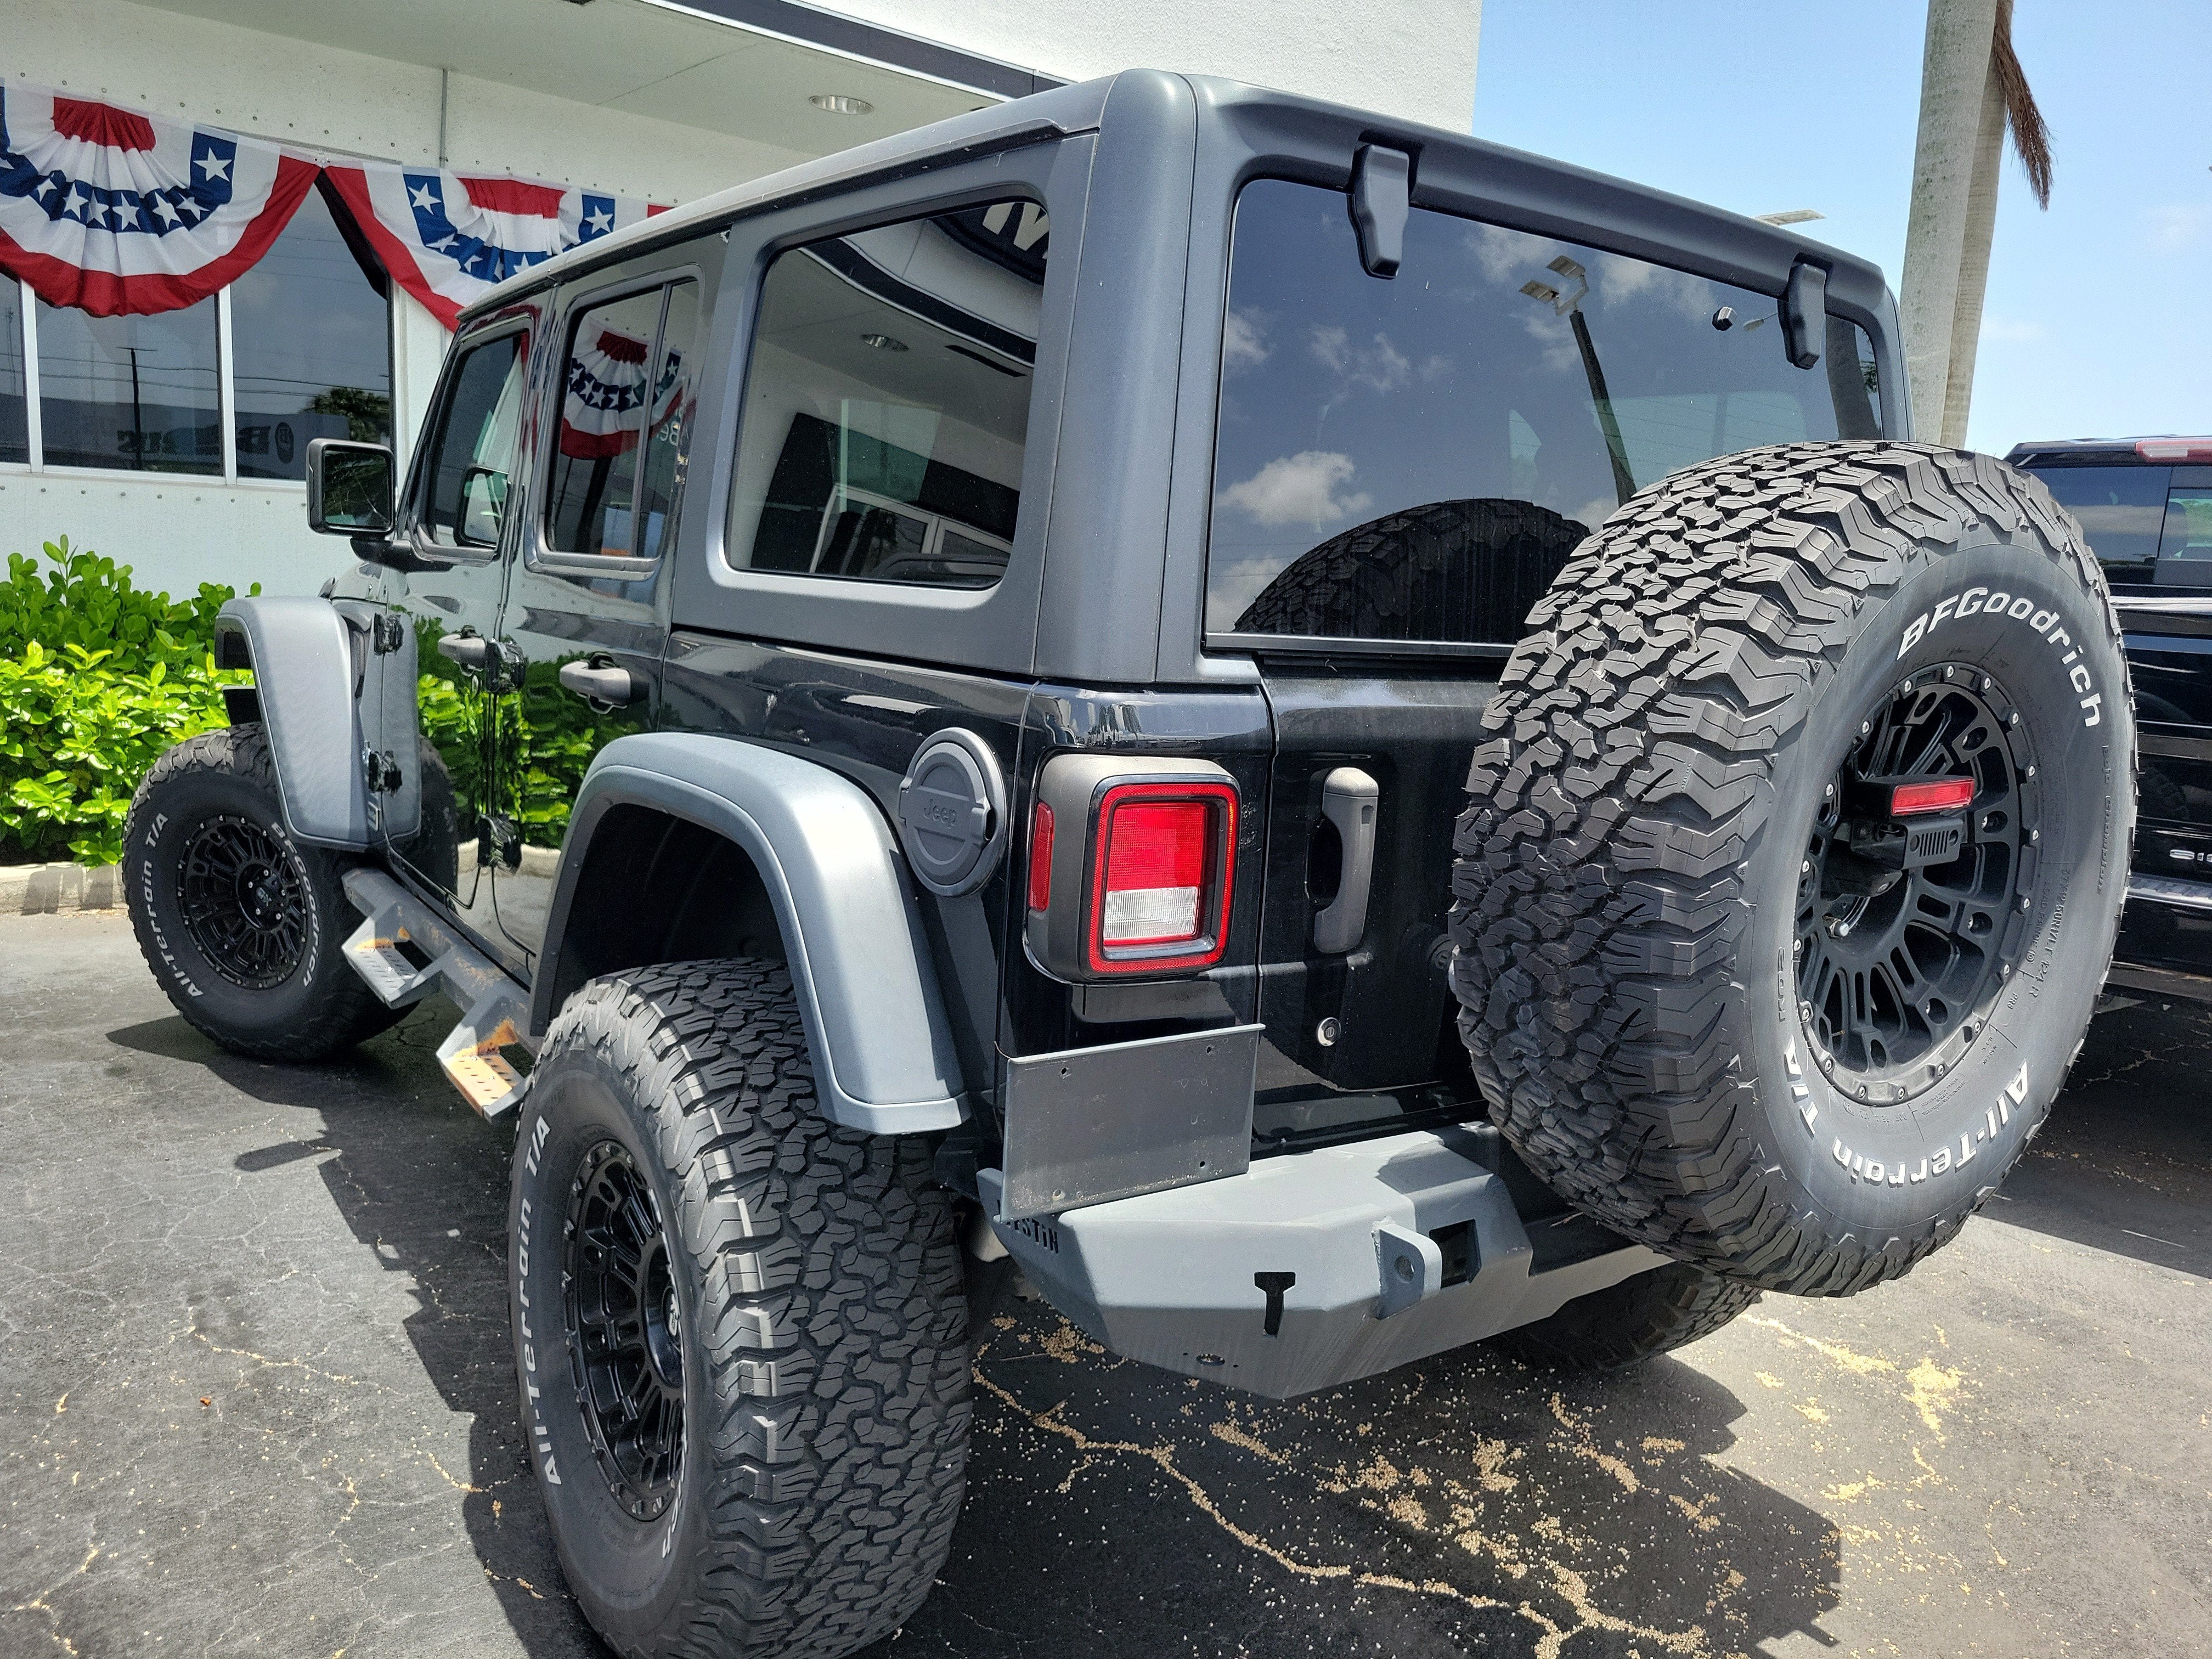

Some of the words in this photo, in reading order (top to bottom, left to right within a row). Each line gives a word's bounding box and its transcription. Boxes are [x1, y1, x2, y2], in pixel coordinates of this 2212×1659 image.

[1896, 586, 2102, 728] BFGoodrich
[145, 812, 168, 848] T/A
[923, 798, 957, 830] Jeep
[141, 860, 204, 997] All-Terrain
[271, 821, 320, 987] BFGoodrich
[525, 1115, 551, 1176] T/A
[1784, 1035, 1819, 1139] T/A
[1832, 1059, 2029, 1189] All-Terrain
[518, 1198, 562, 1486] All-Terrain
